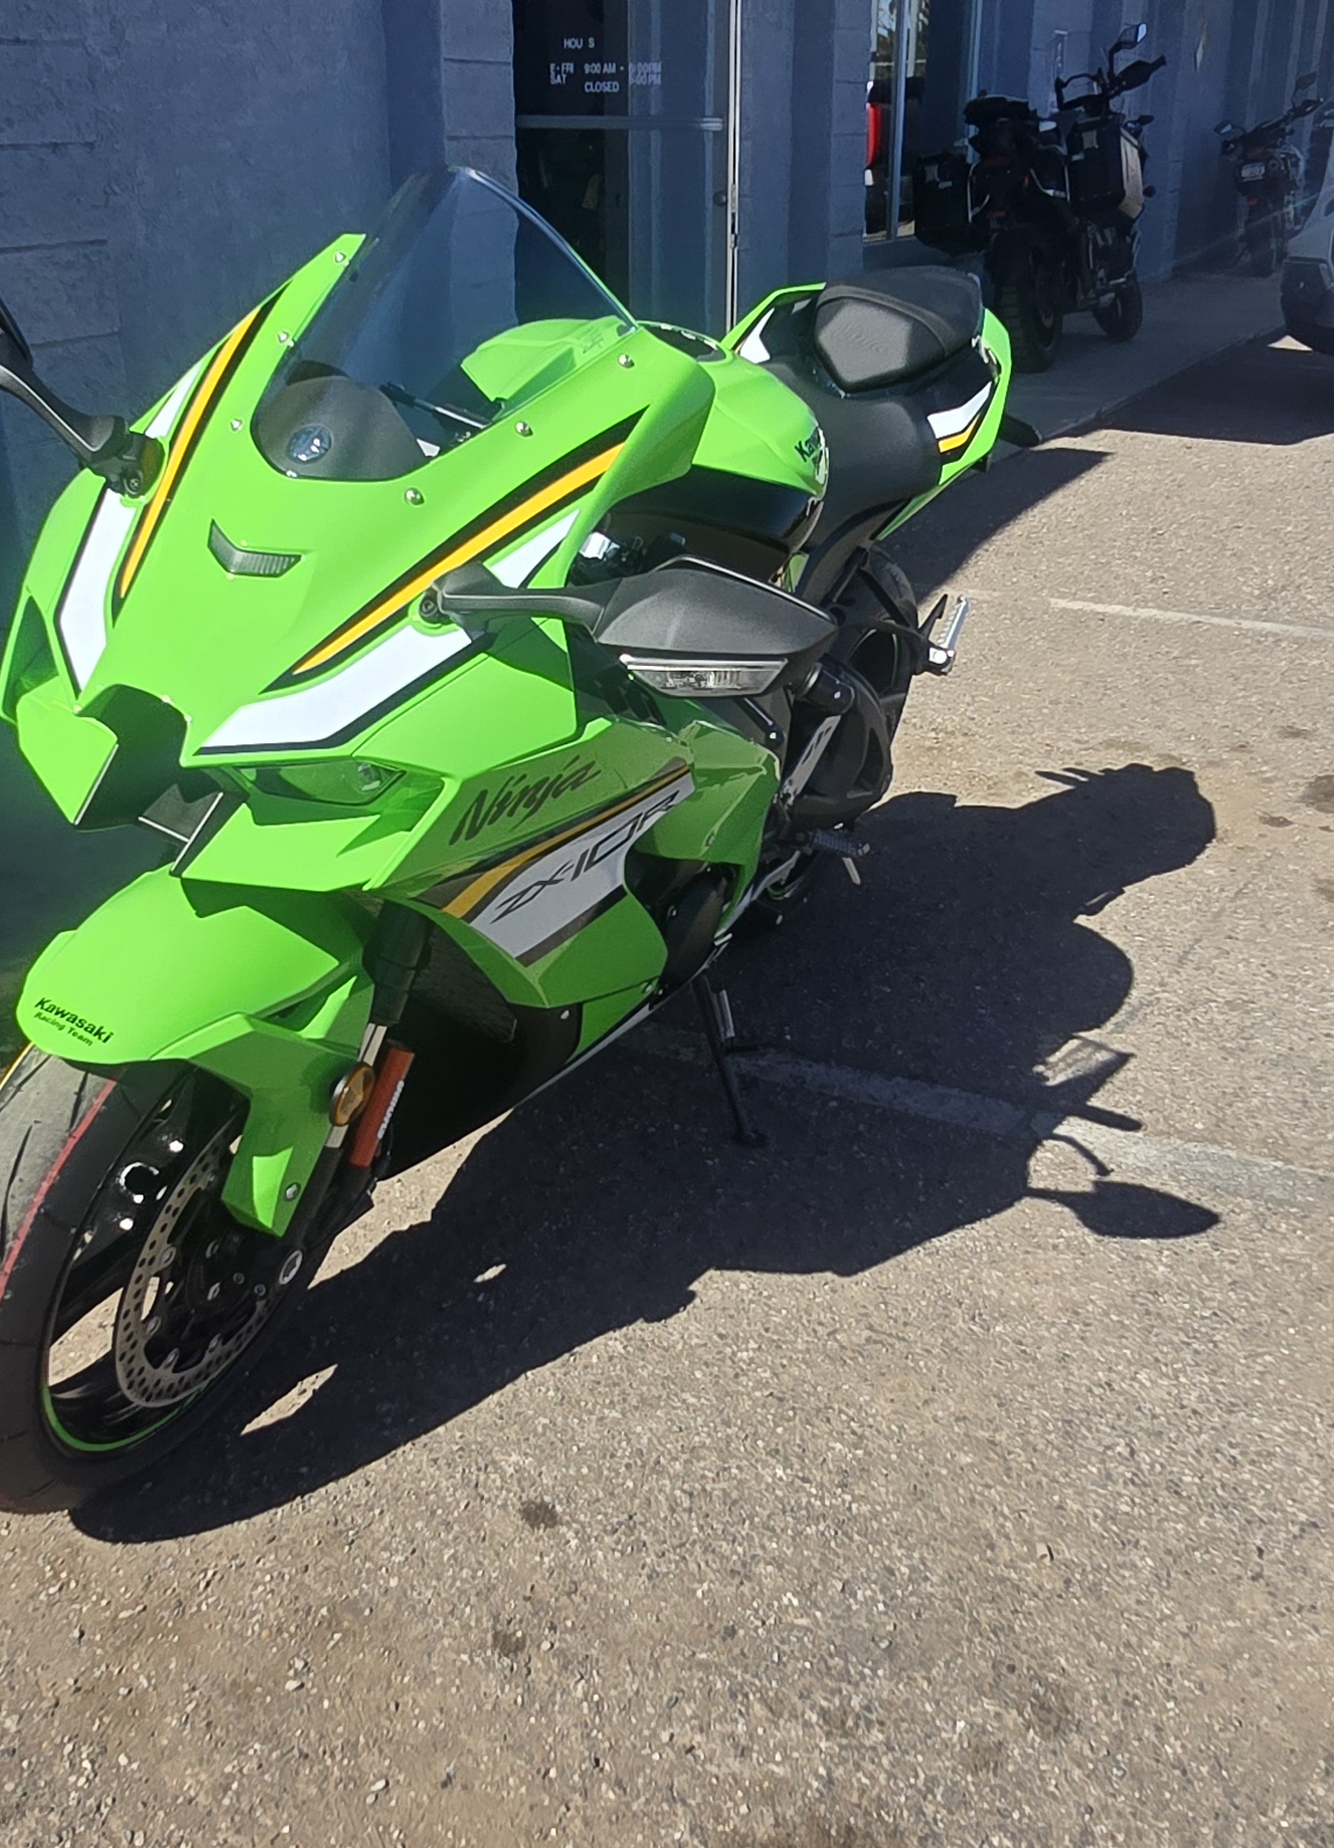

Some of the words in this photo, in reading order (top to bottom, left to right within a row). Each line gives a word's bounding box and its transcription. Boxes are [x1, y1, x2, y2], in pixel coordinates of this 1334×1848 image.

[584, 81, 620, 93] CLOSED
[449, 755, 602, 846] Ninja
[490, 789, 680, 925] ZX-10R
[33, 1011, 66, 1032] Racing
[67, 1026, 93, 1047] Team
[34, 997, 114, 1043] Kawasaki
